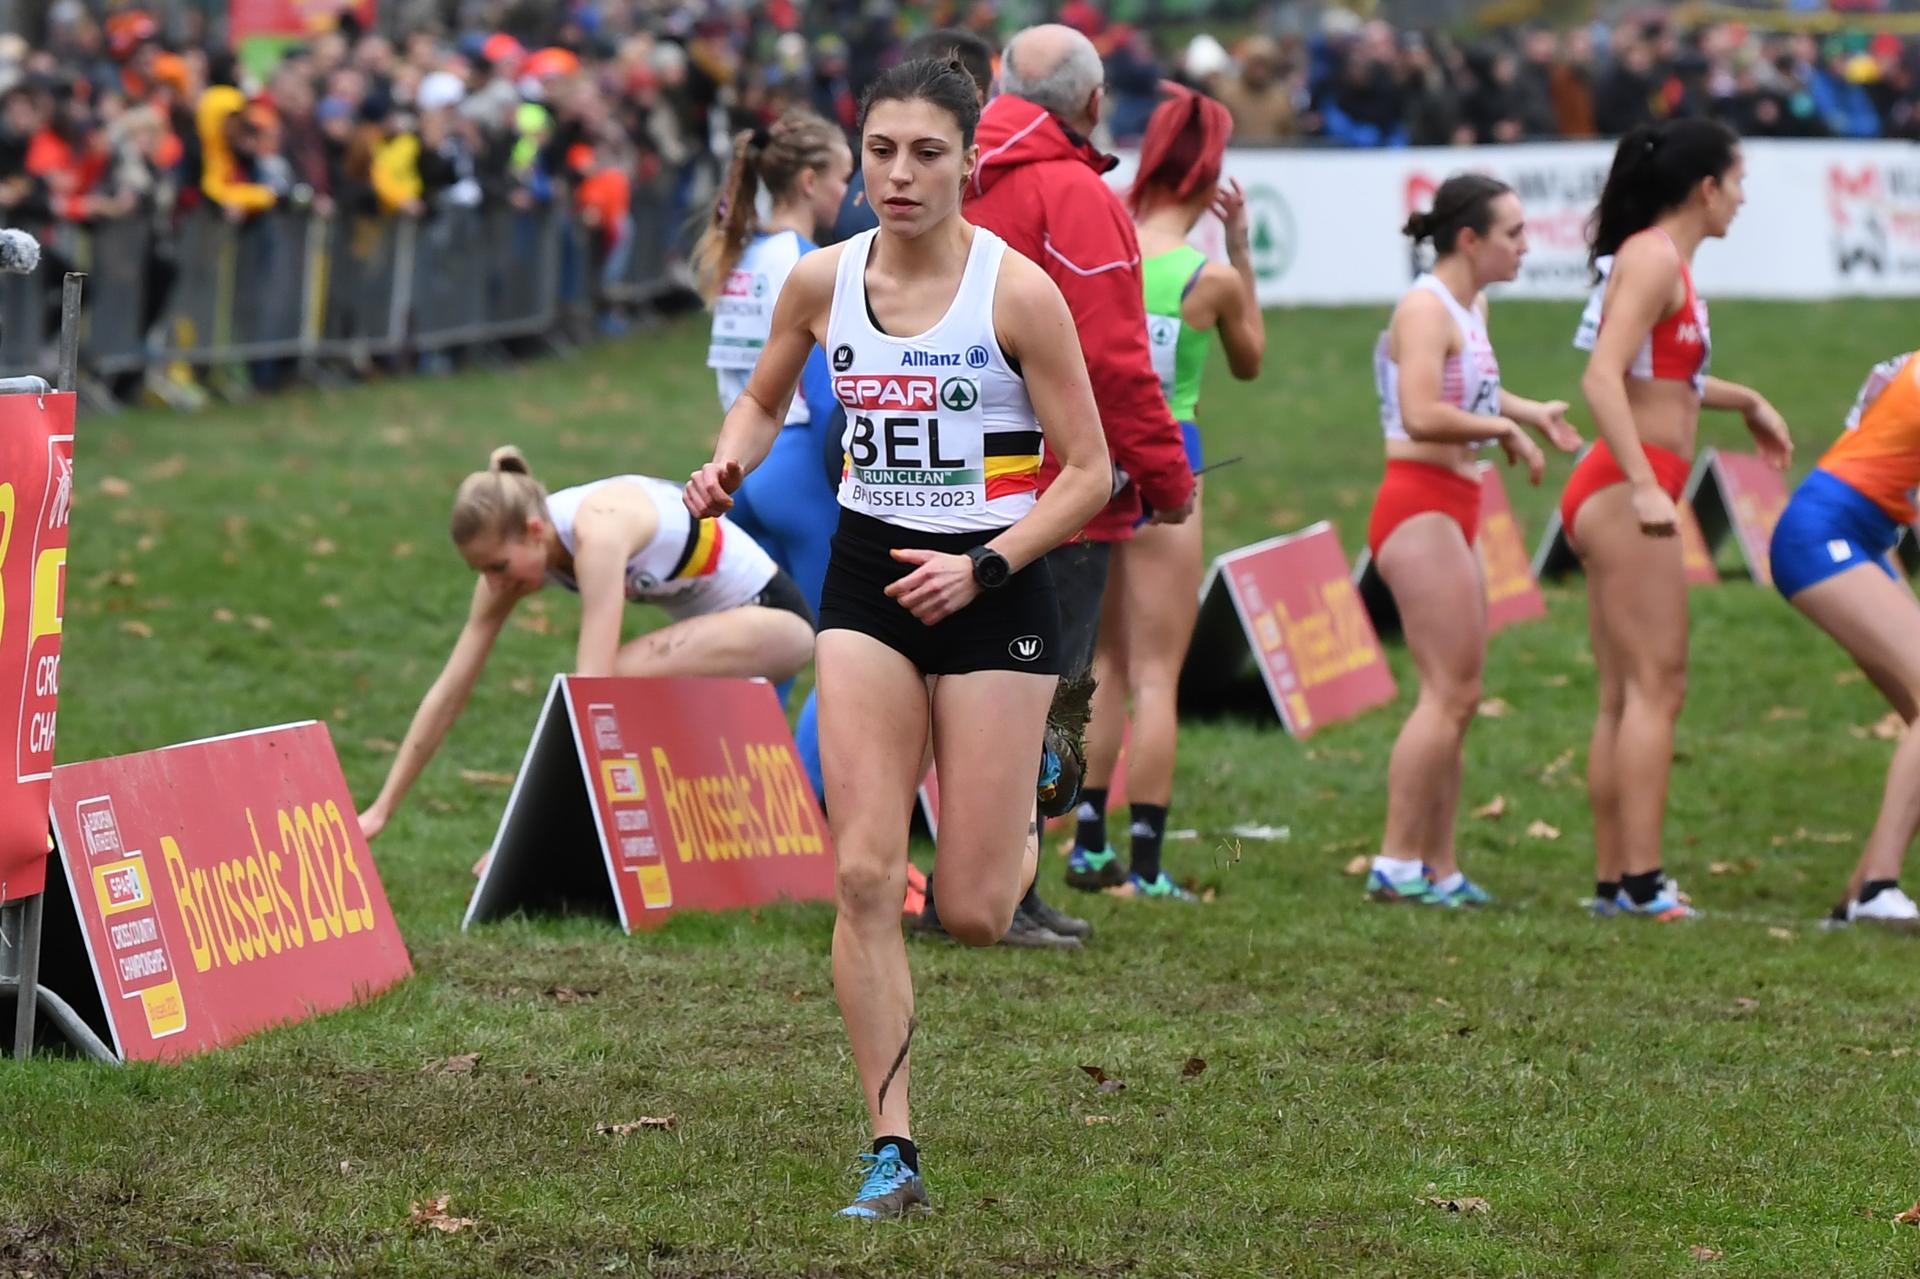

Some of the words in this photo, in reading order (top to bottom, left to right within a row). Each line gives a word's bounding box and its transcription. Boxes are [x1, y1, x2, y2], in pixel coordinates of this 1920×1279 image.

[901, 350, 962, 367] Allianz
[836, 379, 934, 406] SPAR
[849, 415, 965, 469] BEL
[863, 471, 891, 484] RUN
[930, 490, 976, 507] 2023
[652, 737, 772, 863] Brussels
[160, 806, 302, 973] Brussels
[277, 799, 375, 943] 2023
